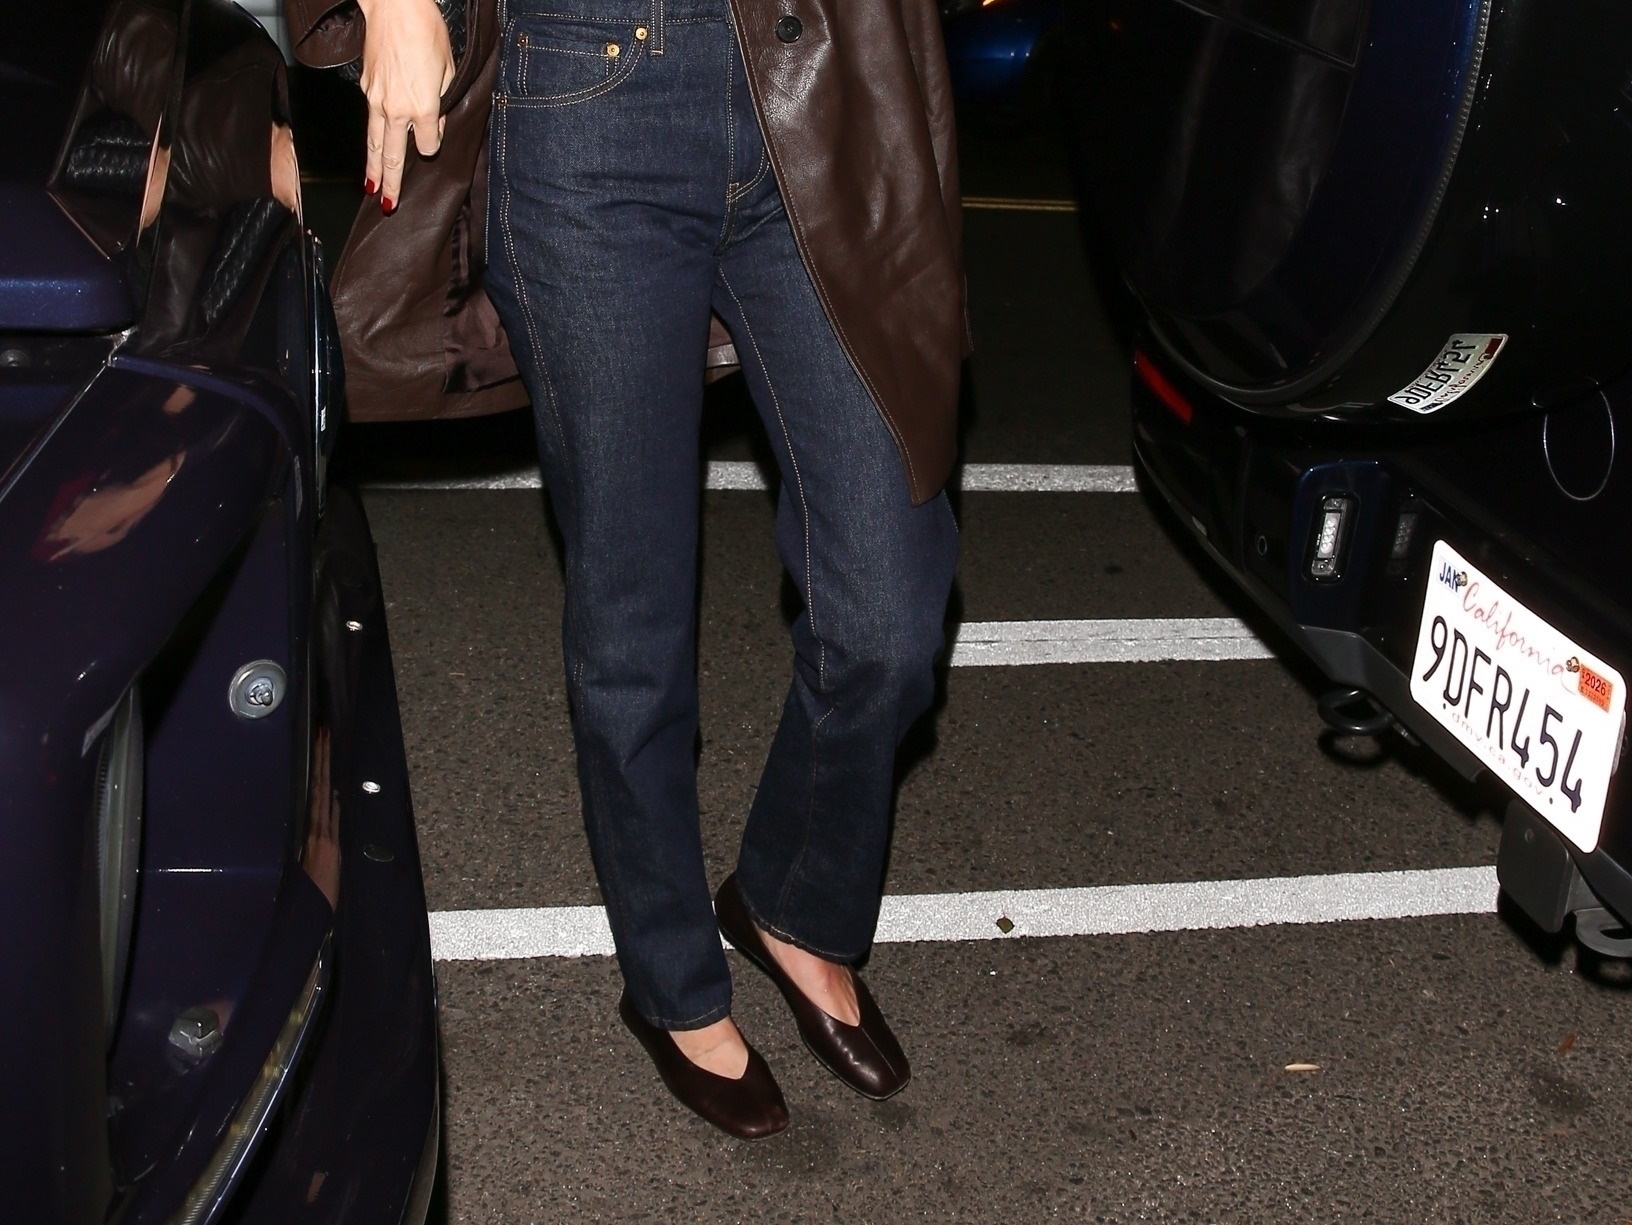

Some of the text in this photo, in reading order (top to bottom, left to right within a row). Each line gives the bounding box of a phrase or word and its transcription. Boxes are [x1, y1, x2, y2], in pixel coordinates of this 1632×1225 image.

[1462, 581, 1577, 695] California
[1584, 672, 1607, 696] 2026
[1423, 615, 1583, 813] 9DFR454
[1452, 710, 1543, 796] dmv.ca.gov
